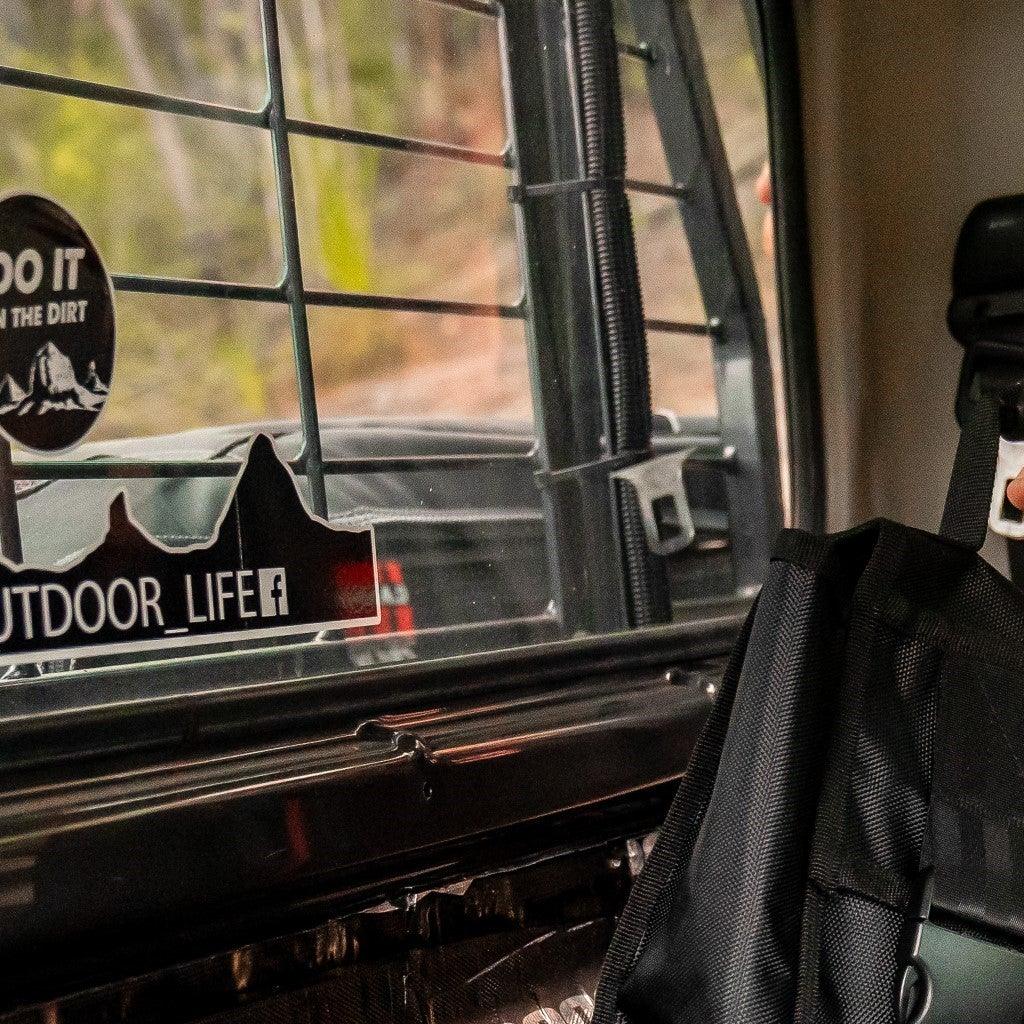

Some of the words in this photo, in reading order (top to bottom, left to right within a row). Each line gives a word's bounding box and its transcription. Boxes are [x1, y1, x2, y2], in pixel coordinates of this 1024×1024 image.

[52, 247, 87, 292] IT
[10, 305, 43, 328] THE
[46, 300, 89, 325] DIRT
